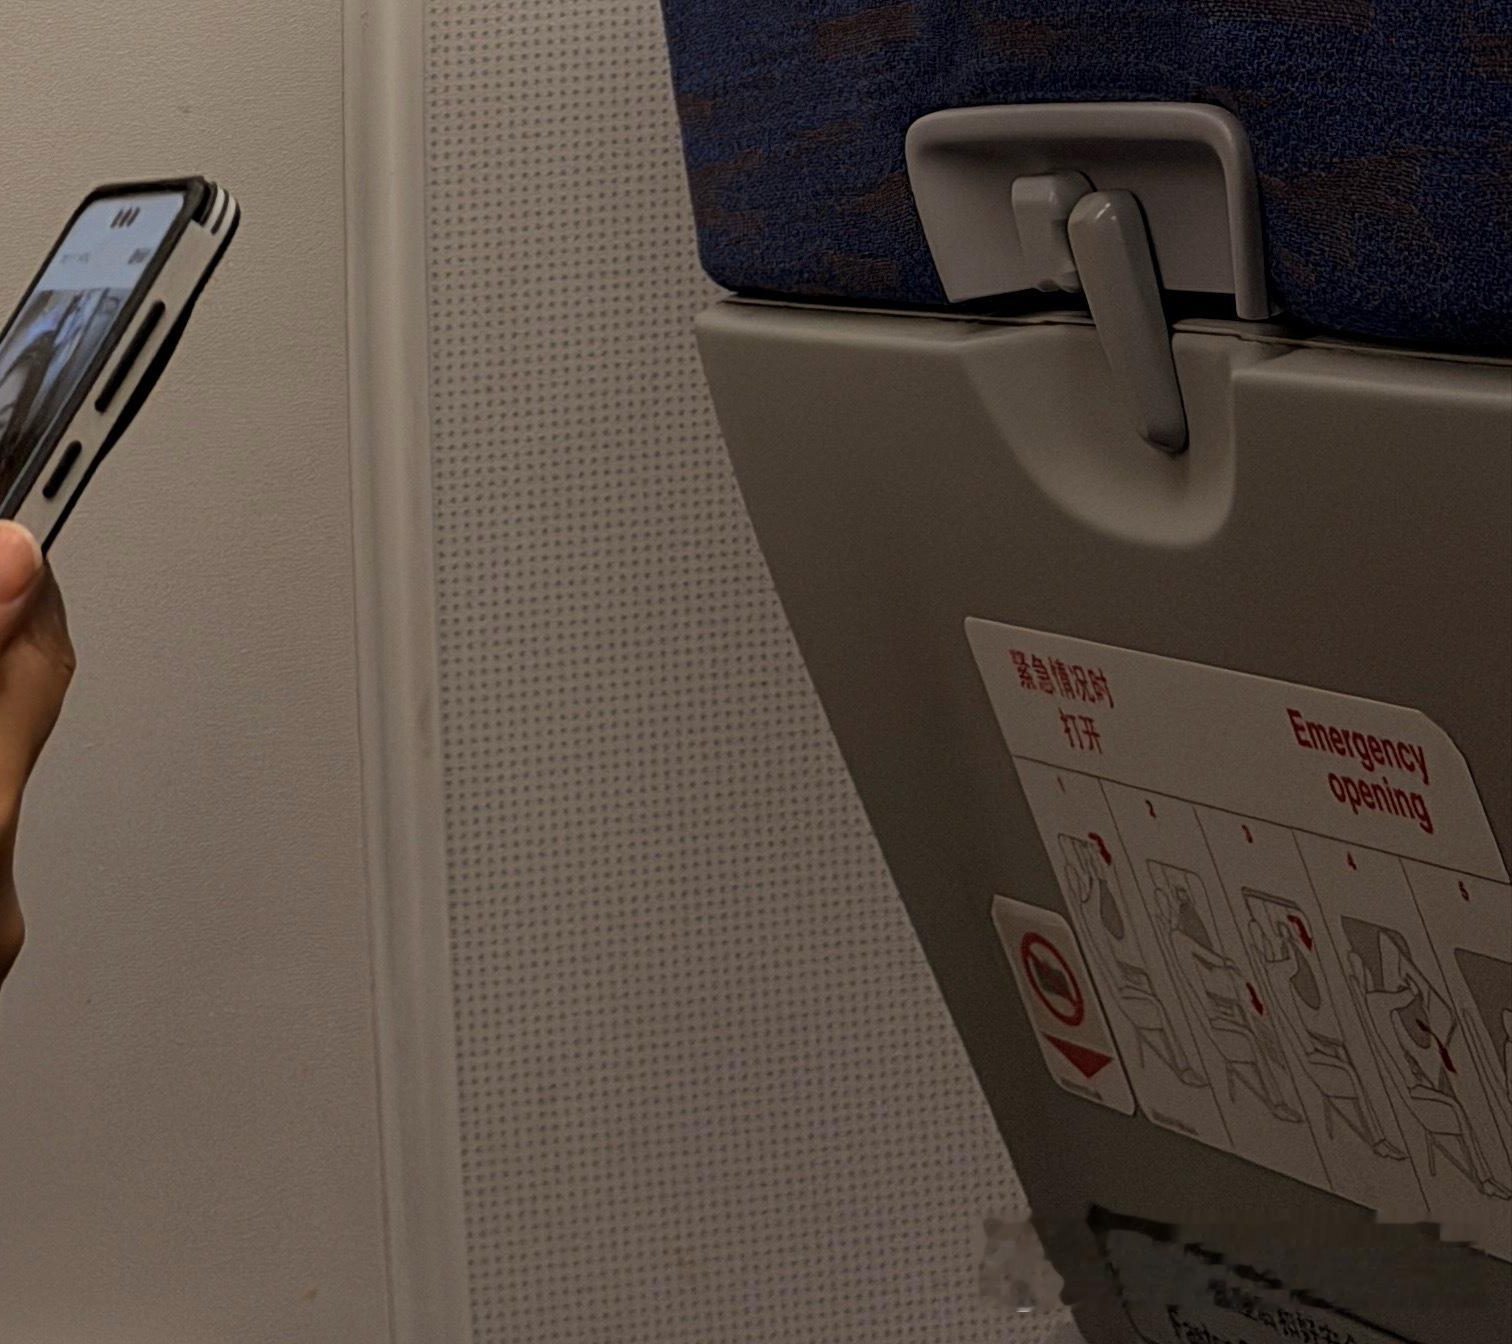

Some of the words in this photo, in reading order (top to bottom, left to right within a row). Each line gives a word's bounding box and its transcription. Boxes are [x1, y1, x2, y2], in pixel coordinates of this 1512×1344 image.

[1008, 648, 1115, 709] 紧急情况时
[1057, 706, 1103, 754] 打开
[1286, 707, 1430, 786] Emergency
[1327, 771, 1434, 835] opening
[1144, 798, 1157, 818] 2
[1346, 850, 1358, 871] 4
[1457, 879, 1471, 902] 5
